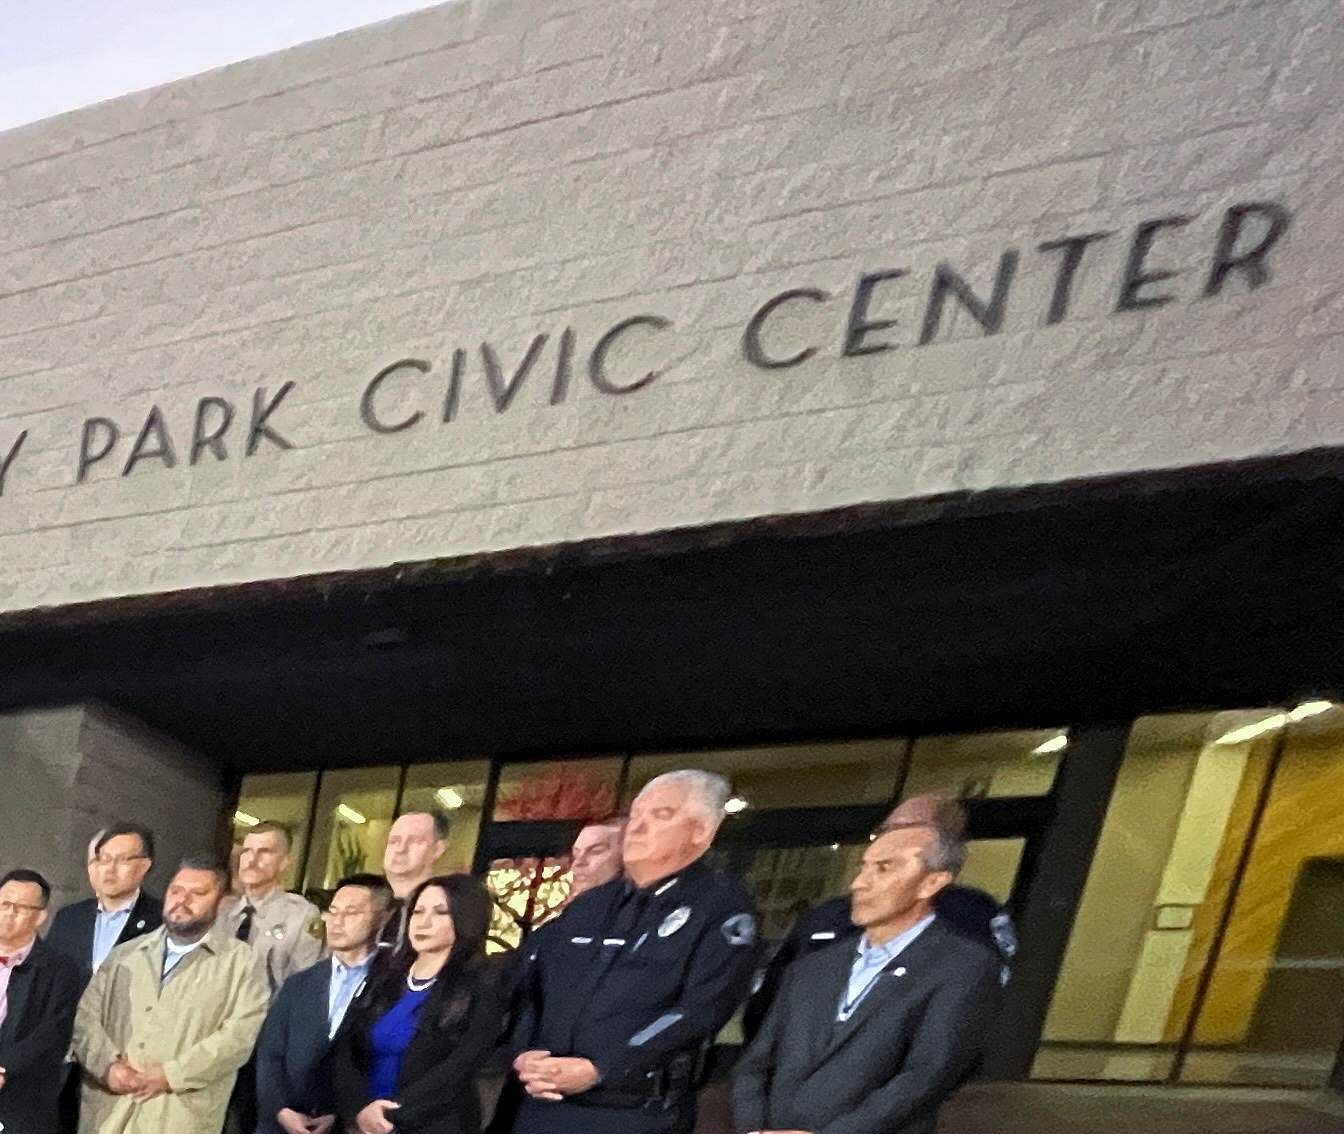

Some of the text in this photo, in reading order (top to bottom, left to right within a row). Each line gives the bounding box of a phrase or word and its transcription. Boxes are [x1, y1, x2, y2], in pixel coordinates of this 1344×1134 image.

[76, 380, 296, 484] PARK
[359, 314, 674, 436] CIVIC
[742, 200, 1293, 370] CENTER
